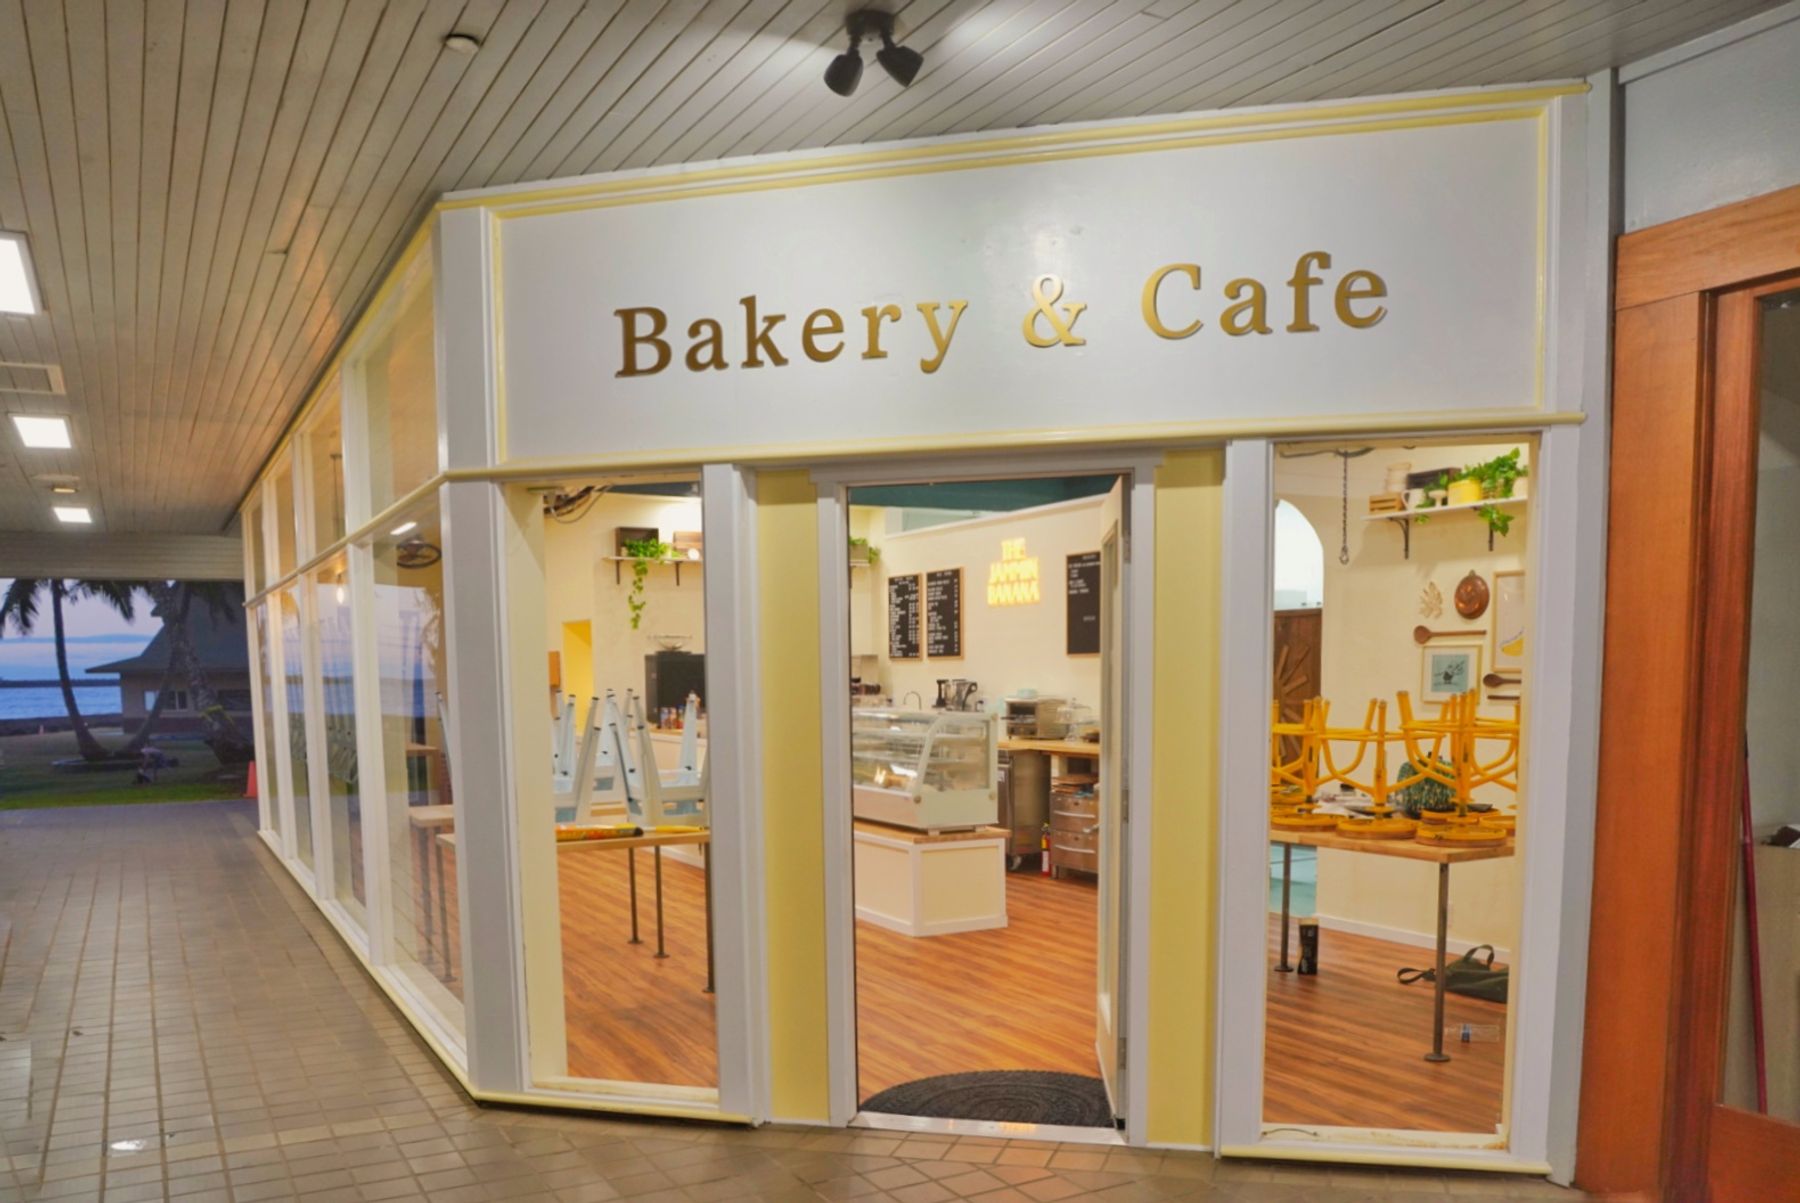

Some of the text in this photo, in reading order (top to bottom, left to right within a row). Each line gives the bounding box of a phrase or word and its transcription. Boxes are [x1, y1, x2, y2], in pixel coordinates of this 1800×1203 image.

[613, 251, 1388, 378] Bakery & Cafe
